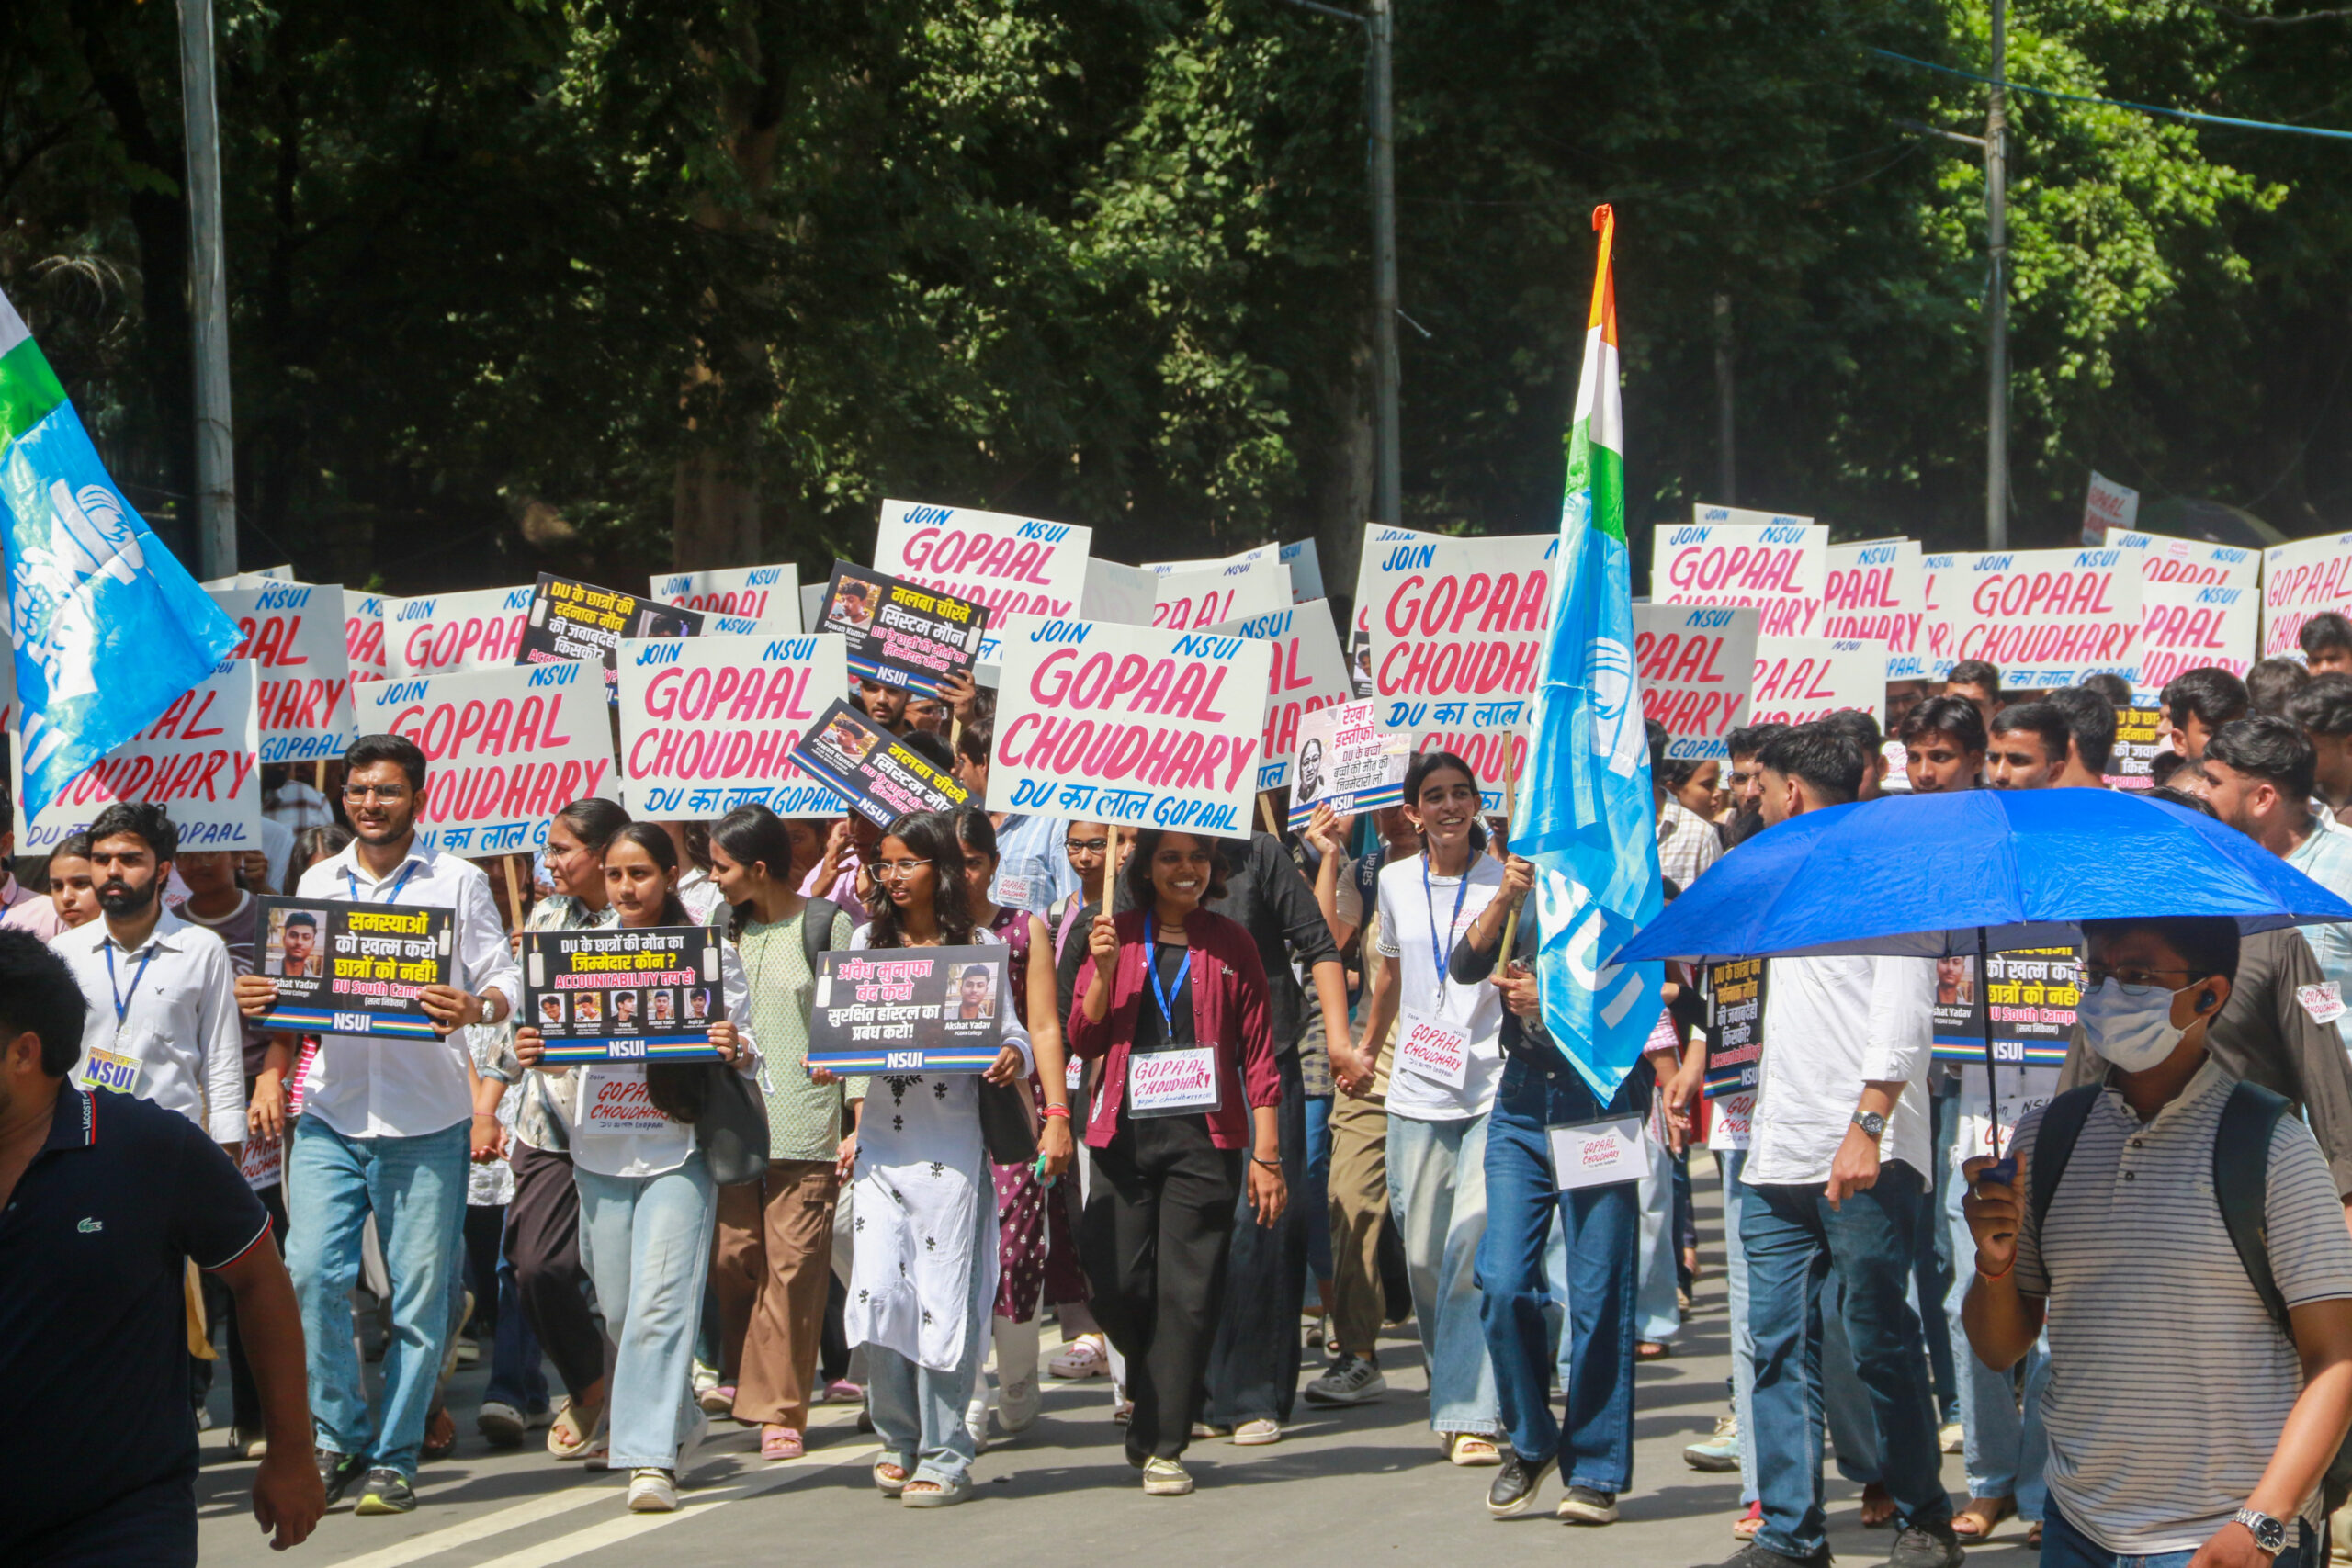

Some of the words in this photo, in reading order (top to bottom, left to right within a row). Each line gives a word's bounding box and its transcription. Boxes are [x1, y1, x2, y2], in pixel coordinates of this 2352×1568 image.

[903, 505, 954, 526] JOIN
[1016, 521, 1070, 543] NSUI
[1705, 508, 1729, 521] JOIN
[1670, 526, 1712, 546] JOIN
[1758, 526, 1806, 544] NSUI
[2118, 534, 2153, 550] JOIN
[2211, 548, 2249, 564] NSUI
[901, 527, 1056, 586] GOPAAL
[1223, 562, 1251, 577] NSUI
[1382, 544, 1437, 572] JOIN
[1669, 546, 1804, 594] GOPAAL
[1857, 547, 1897, 566] NSUI
[1973, 554, 2015, 571] JOIN
[2074, 550, 2120, 568] NSUI
[661, 575, 693, 596] JOIN
[745, 568, 781, 587] NSUI
[1973, 571, 2114, 618] GOPAAL
[2267, 555, 2352, 608] GOPAAL
[254, 588, 311, 611] NSUI
[550, 581, 571, 599] DU
[571, 584, 585, 603] के
[585, 590, 617, 613] छात्रों
[616, 596, 635, 616] की
[889, 584, 937, 611] मलबा
[1385, 570, 1549, 637] GOPAA
[2195, 587, 2243, 605] NSUI
[397, 598, 437, 622] JOIN
[554, 599, 598, 624] दर्दनाक
[598, 609, 626, 631] मौत
[1686, 610, 1735, 628] NSUI
[549, 616, 567, 635] की
[568, 622, 622, 649] जवाबदेही
[714, 616, 757, 636] NSUI
[845, 626, 868, 640] Kumar
[879, 604, 932, 638] सिस्टम
[932, 619, 967, 648] मौन
[1238, 609, 1293, 639] NSUI
[554, 636, 605, 660] किसकी?
[636, 642, 684, 666] JOIN
[763, 638, 817, 662] NSUI
[871, 625, 887, 640] DU
[886, 626, 897, 642] के
[953, 649, 969, 665] का
[1030, 619, 1093, 644] JOIN
[1171, 635, 1244, 660] NSUI
[1833, 641, 1862, 652] NSUI
[1957, 622, 2141, 664] CHOUDHARY
[923, 652, 950, 672] कौन?
[376, 680, 429, 706] JOIN
[528, 663, 580, 688] NSUI
[876, 664, 909, 688] NSUI
[1029, 647, 1228, 723] GOPAAL
[2009, 670, 2037, 685] का
[2037, 670, 2075, 686] लाल
[644, 666, 813, 722] GOPAAL
[386, 693, 571, 761] GOPAAL
[1385, 701, 1428, 728] DU
[1432, 701, 1469, 725] का
[1472, 700, 1525, 728] लाल
[259, 733, 346, 762] GOPAAL
[812, 737, 835, 756] Pawan
[832, 750, 858, 771] Kumar
[888, 741, 934, 780] मलबा
[997, 712, 1259, 794] CHOUDHARY
[1342, 749, 1354, 762] DU
[1354, 746, 1363, 760] के
[859, 763, 876, 778] DU
[871, 751, 924, 795] सिस्टम
[1351, 759, 1361, 774] की
[1363, 755, 1378, 773] मौत
[1378, 754, 1389, 770] की
[644, 787, 684, 812] DU
[689, 787, 724, 812] का
[723, 786, 775, 815] लाल
[857, 797, 896, 828] NSUI
[1010, 778, 1057, 808] DU
[1059, 784, 1098, 811] का
[1095, 787, 1154, 820] लाल
[1153, 795, 1238, 831] GOPAAL
[1330, 793, 1355, 812] NSUI
[25, 825, 61, 848] DU
[442, 827, 476, 851] का
[481, 821, 530, 851] लाल
[1362, 852, 1378, 887] safari
[347, 911, 430, 935] समस्याओं
[334, 931, 358, 954] को
[360, 937, 401, 957] खत्म
[403, 935, 437, 960] करो
[560, 938, 578, 953] DU
[579, 935, 593, 952] के
[594, 934, 623, 953] छात्रों
[623, 933, 639, 951] की
[640, 932, 666, 950] मौत
[667, 934, 684, 949] का
[333, 954, 374, 978] छात्रों
[373, 957, 399, 980] को
[398, 959, 438, 983] नहीं!
[570, 951, 633, 973] जिम्मेदार
[633, 950, 666, 971] कौन
[668, 953, 677, 969] ?
[837, 957, 876, 980] अवैध
[877, 959, 934, 984] मुनाफा
[2007, 960, 2050, 981] खत्म
[294, 979, 319, 990] Yadav
[332, 977, 351, 995] DU
[351, 980, 389, 998] South
[554, 972, 659, 990] ACCOUNTABILITY
[659, 970, 679, 987] तय
[680, 966, 696, 986] हो
[855, 981, 879, 1002] बंद
[880, 979, 914, 1002] करो
[2022, 981, 2046, 1006] को
[333, 1012, 371, 1032] NSUI
[827, 1003, 875, 1026] सुरक्षित
[876, 1001, 922, 1022] हॉस्टल
[922, 1003, 941, 1020] का
[944, 1021, 968, 1030] Akshat
[969, 1021, 991, 1031] Yadav
[1949, 1008, 1972, 1019] Yadav
[2002, 1007, 2039, 1023] South
[852, 1021, 881, 1041] प्रबंध
[882, 1020, 914, 1040] करो!
[1411, 1023, 1463, 1055] GOPAAL
[608, 1040, 646, 1058] NSUI
[886, 1051, 923, 1069] NSUI
[1403, 1042, 1463, 1072] CHOUDHARY
[85, 1056, 136, 1091] NSUI
[1134, 1058, 1207, 1081] GOPAAL
[81, 1097, 92, 1131] LACOSTE
